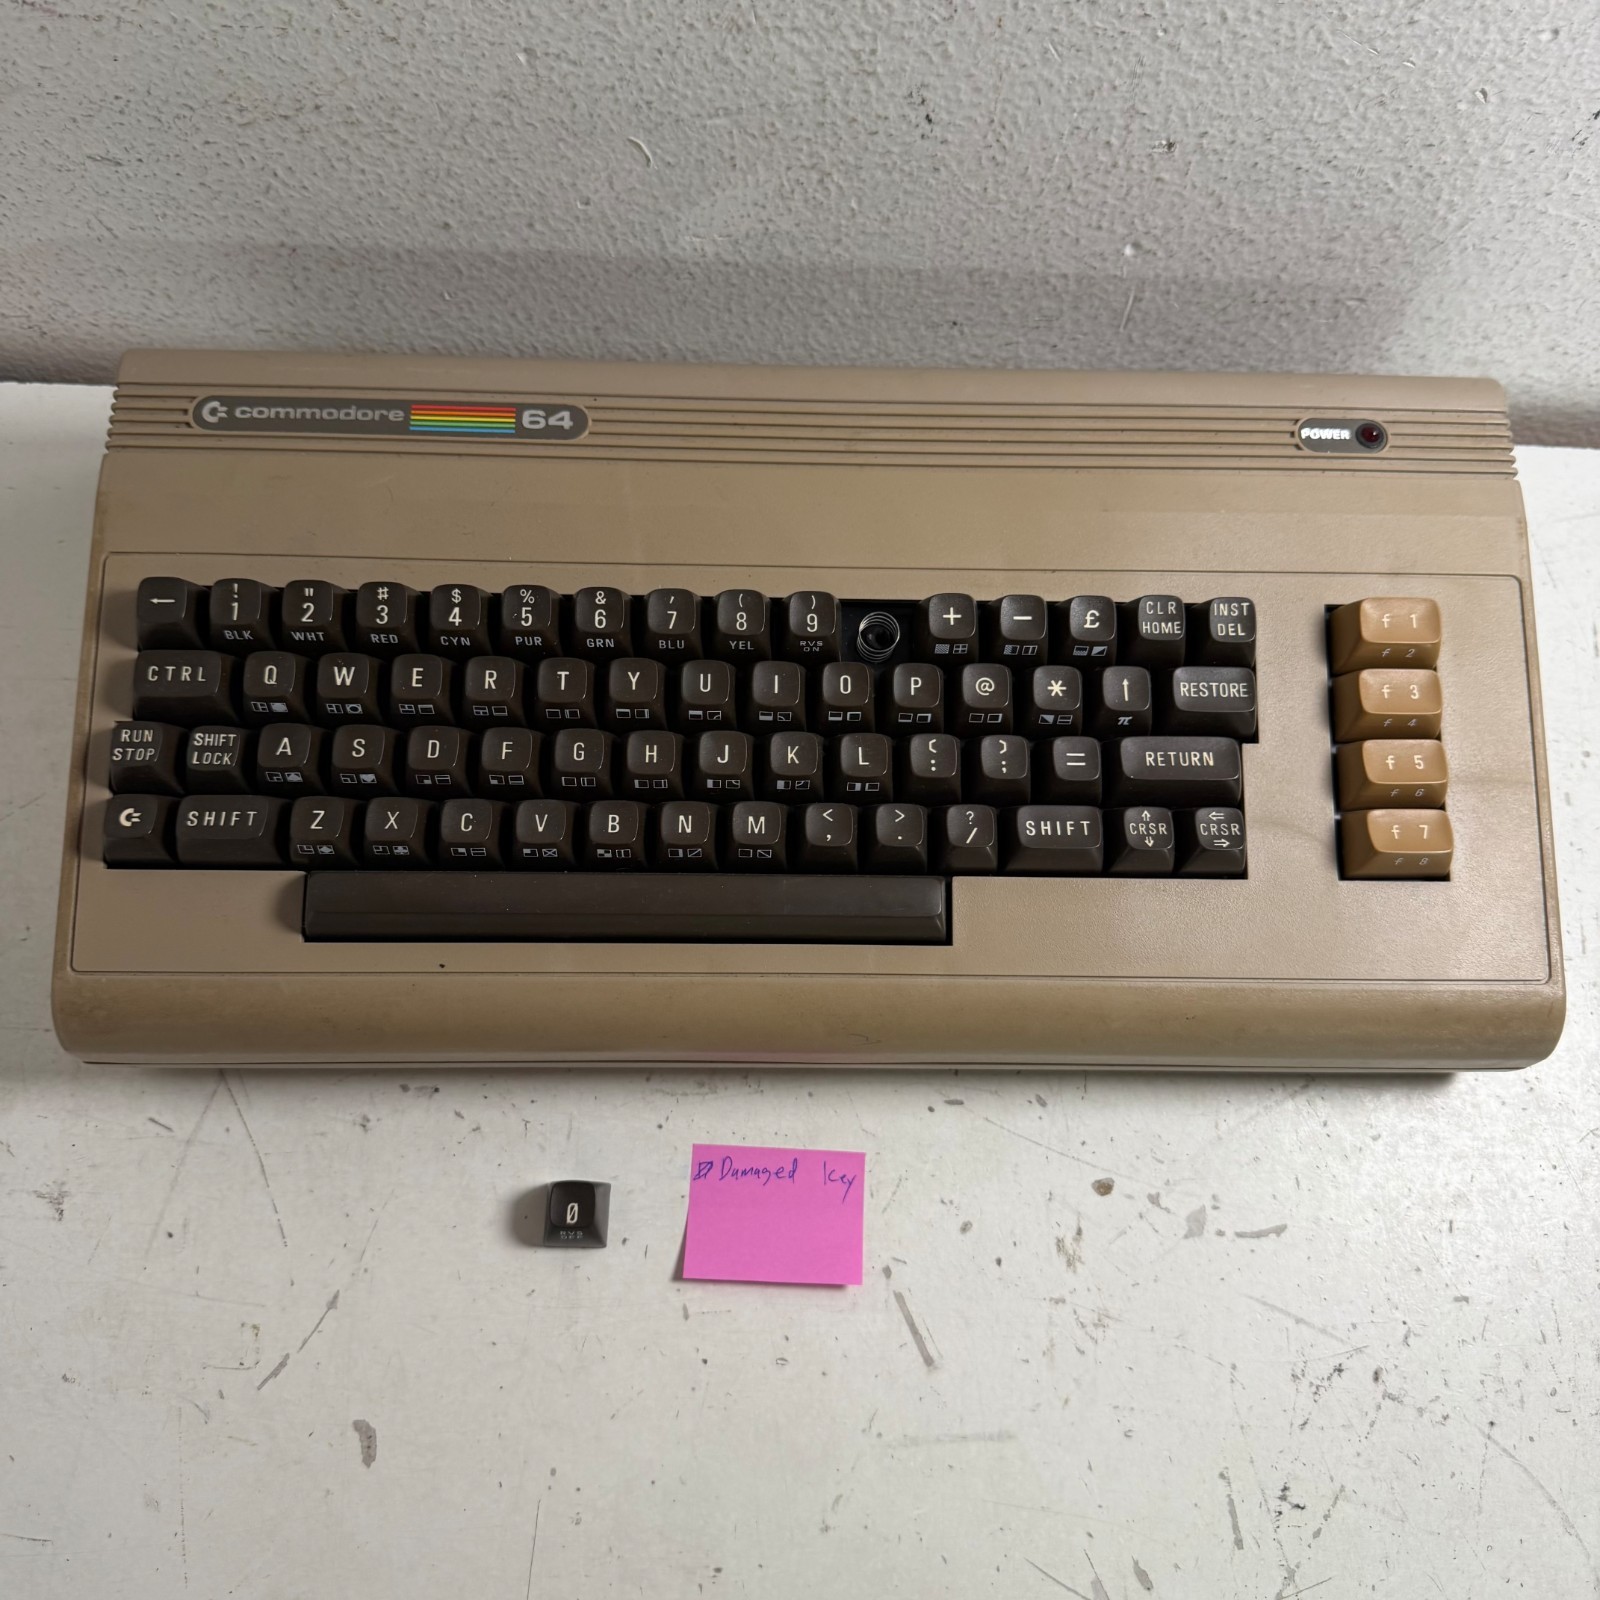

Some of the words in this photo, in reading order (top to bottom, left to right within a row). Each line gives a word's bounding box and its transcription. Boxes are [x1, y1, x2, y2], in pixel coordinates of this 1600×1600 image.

[235, 406, 404, 422] commodore
[522, 410, 573, 430] 64
[1301, 428, 1351, 440] POWER
[377, 586, 389, 600] #
[451, 589, 461, 603] $
[520, 589, 535, 604] %
[595, 591, 607, 604] &
[231, 602, 238, 621] 1
[301, 602, 314, 623] 2
[376, 605, 388, 625] 3
[448, 606, 462, 626] 4
[942, 607, 962, 625] +
[1146, 601, 1177, 615] CLR
[1214, 603, 1250, 616] INST
[520, 607, 533, 627] 5
[594, 609, 606, 629] 6
[666, 610, 678, 630] 7
[736, 611, 747, 631] 8
[806, 613, 818, 632] 9
[1083, 609, 1100, 628] £
[1410, 614, 1417, 628] 1
[1142, 620, 1182, 634] HOME
[1217, 623, 1246, 636] DEL
[224, 630, 254, 641] BLK
[290, 631, 325, 642] WHT
[370, 633, 399, 644] RED
[440, 636, 471, 647] CYN
[515, 636, 543, 647] PUR
[586, 638, 615, 648] GRN
[658, 640, 685, 650] BLU
[729, 641, 754, 651] YEL
[1405, 649, 1415, 658] 2
[147, 665, 207, 682] CTRL
[264, 665, 277, 685] Q
[334, 666, 355, 686] W
[412, 667, 424, 688] E
[485, 670, 497, 689] R
[557, 671, 569, 691] T
[627, 671, 640, 691] Y
[700, 673, 711, 692] U
[839, 675, 852, 695] O
[910, 676, 922, 695] P
[975, 677, 995, 696] @
[1180, 682, 1249, 698] RESTORE
[1410, 685, 1420, 699] 3
[1407, 719, 1417, 727] 4
[120, 729, 153, 743] RUN
[193, 732, 237, 747] SHIFT
[112, 748, 156, 761] STOP
[276, 737, 292, 756] A
[352, 738, 366, 758] S
[427, 740, 440, 759] D
[501, 742, 513, 760] F
[573, 742, 585, 761] G
[645, 744, 658, 763] H
[717, 745, 729, 763] J
[787, 745, 799, 764] K
[192, 752, 232, 766] LOCK
[858, 747, 869, 765] L
[1146, 752, 1215, 767] RETURN
[1414, 755, 1424, 769] 5
[1415, 789, 1424, 797] 6
[186, 811, 258, 827] SHIFT
[310, 811, 326, 830] Z
[384, 811, 400, 830] X
[460, 813, 474, 832] C
[535, 814, 548, 832] V
[608, 814, 620, 833] B
[822, 809, 833, 822] <
[894, 809, 905, 822] >
[966, 811, 974, 824] ?
[678, 815, 692, 833] N
[748, 816, 766, 834] M
[1025, 821, 1091, 836] SHIFT
[1129, 820, 1168, 835] CRSR
[1200, 823, 1240, 836] CRSR
[1419, 825, 1429, 839] 7
[966, 827, 978, 843] /
[1419, 857, 1429, 865] 8
